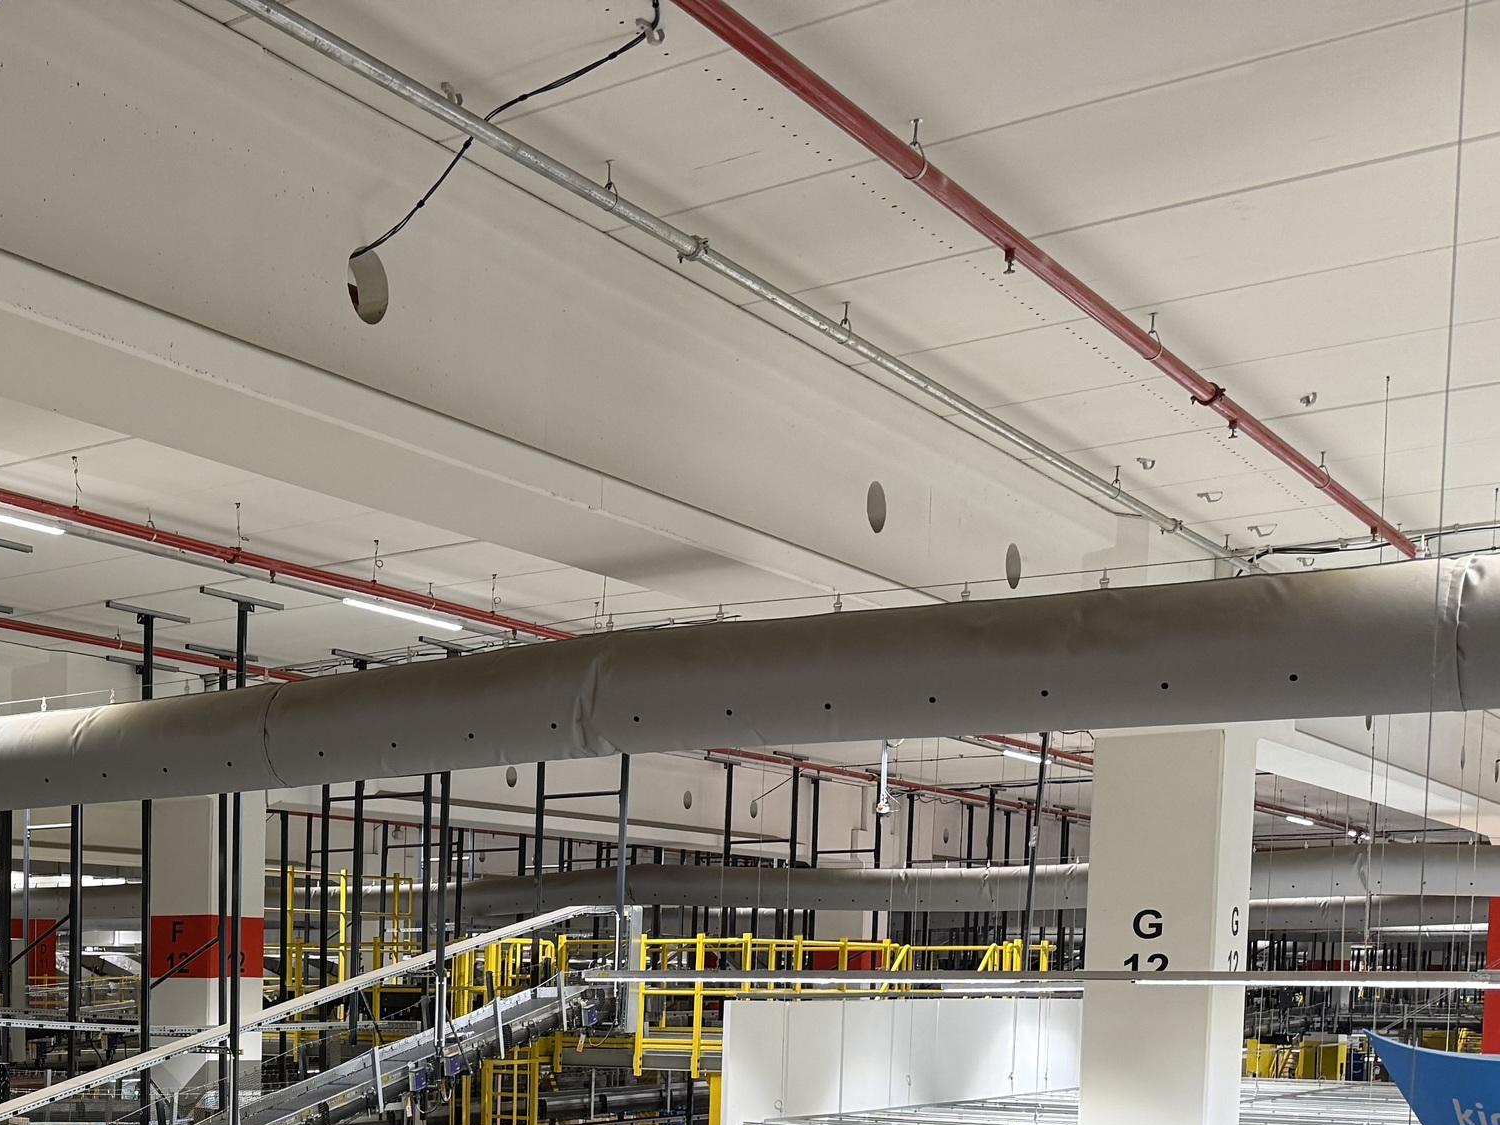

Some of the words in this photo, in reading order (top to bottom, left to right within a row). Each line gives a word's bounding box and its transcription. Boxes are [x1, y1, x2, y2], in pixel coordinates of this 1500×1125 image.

[171, 920, 185, 943] F
[1132, 909, 1163, 940] G
[1231, 906, 1240, 937] G
[166, 951, 190, 974] 12
[1123, 953, 1170, 972] 12
[1227, 950, 1239, 972] 12
